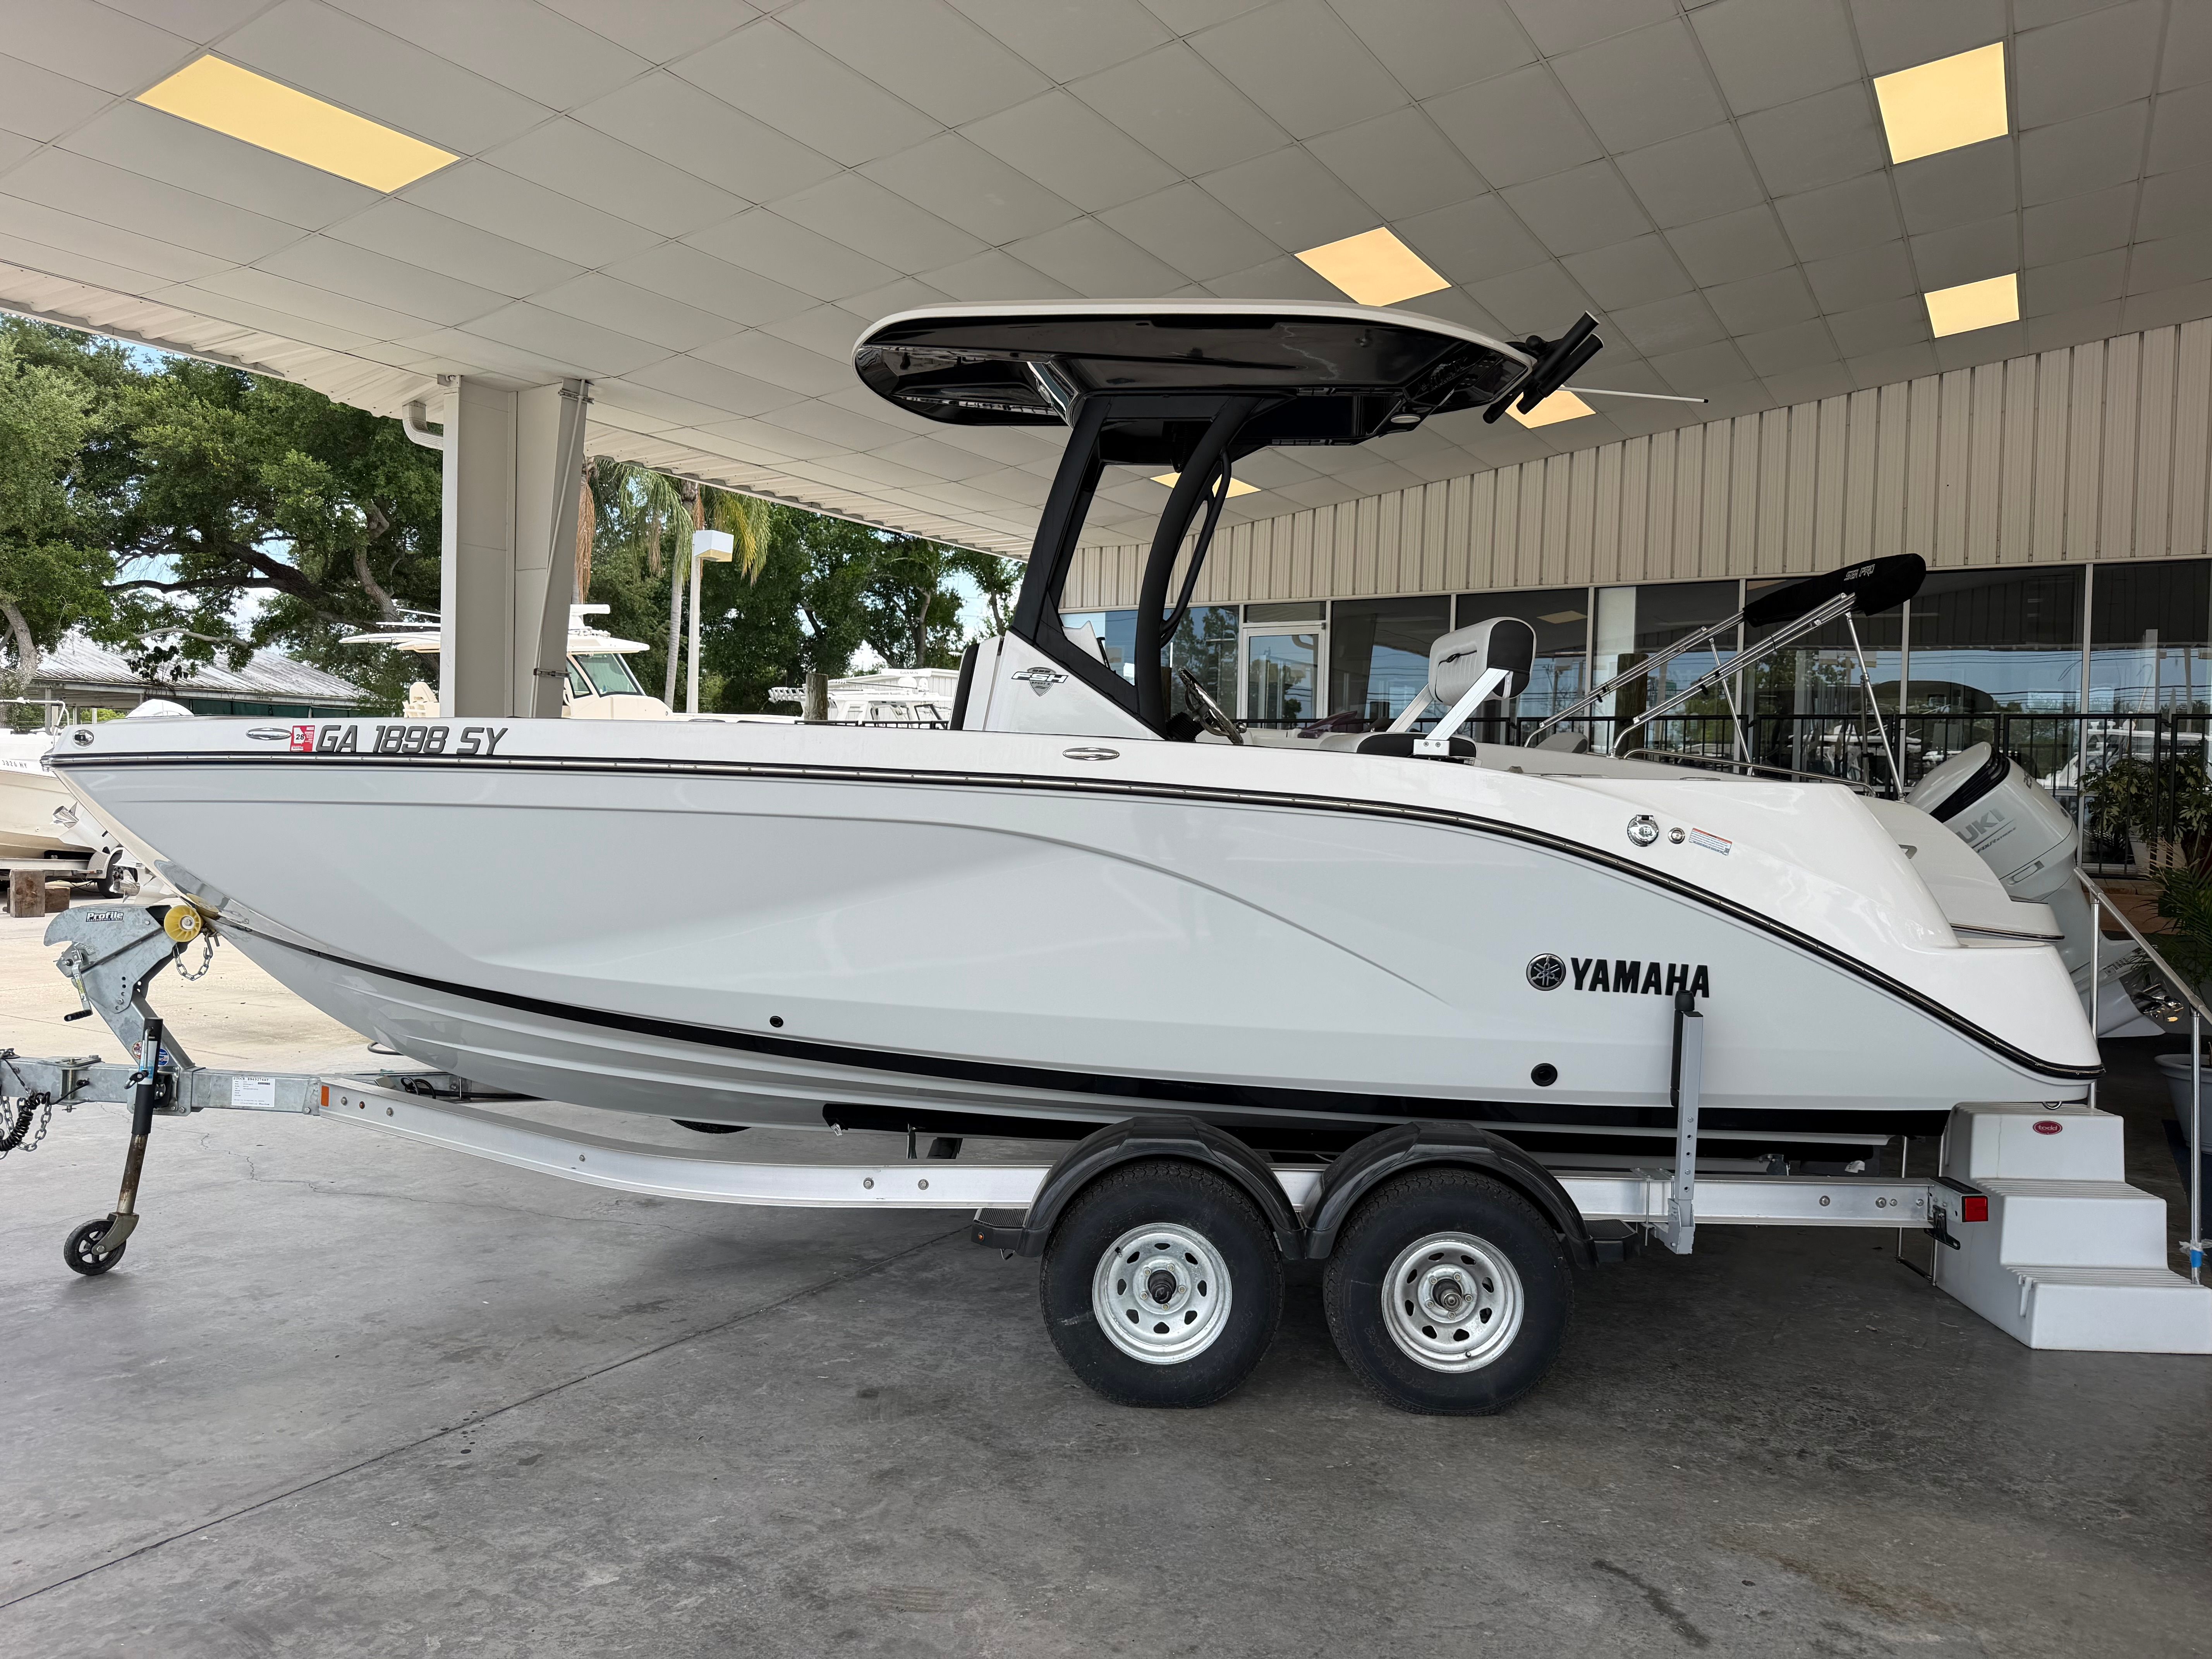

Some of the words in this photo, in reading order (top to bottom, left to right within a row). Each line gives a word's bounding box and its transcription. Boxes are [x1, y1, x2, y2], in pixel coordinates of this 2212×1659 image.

[1844, 569, 1859, 581] SEA
[1859, 564, 1875, 577] PRO
[1012, 672, 1067, 683] FSH
[316, 725, 358, 752] GA
[373, 725, 450, 753] 1898
[456, 727, 508, 755] SY
[87, 911, 124, 919] Profile
[1570, 957, 1710, 998] YAMAHA
